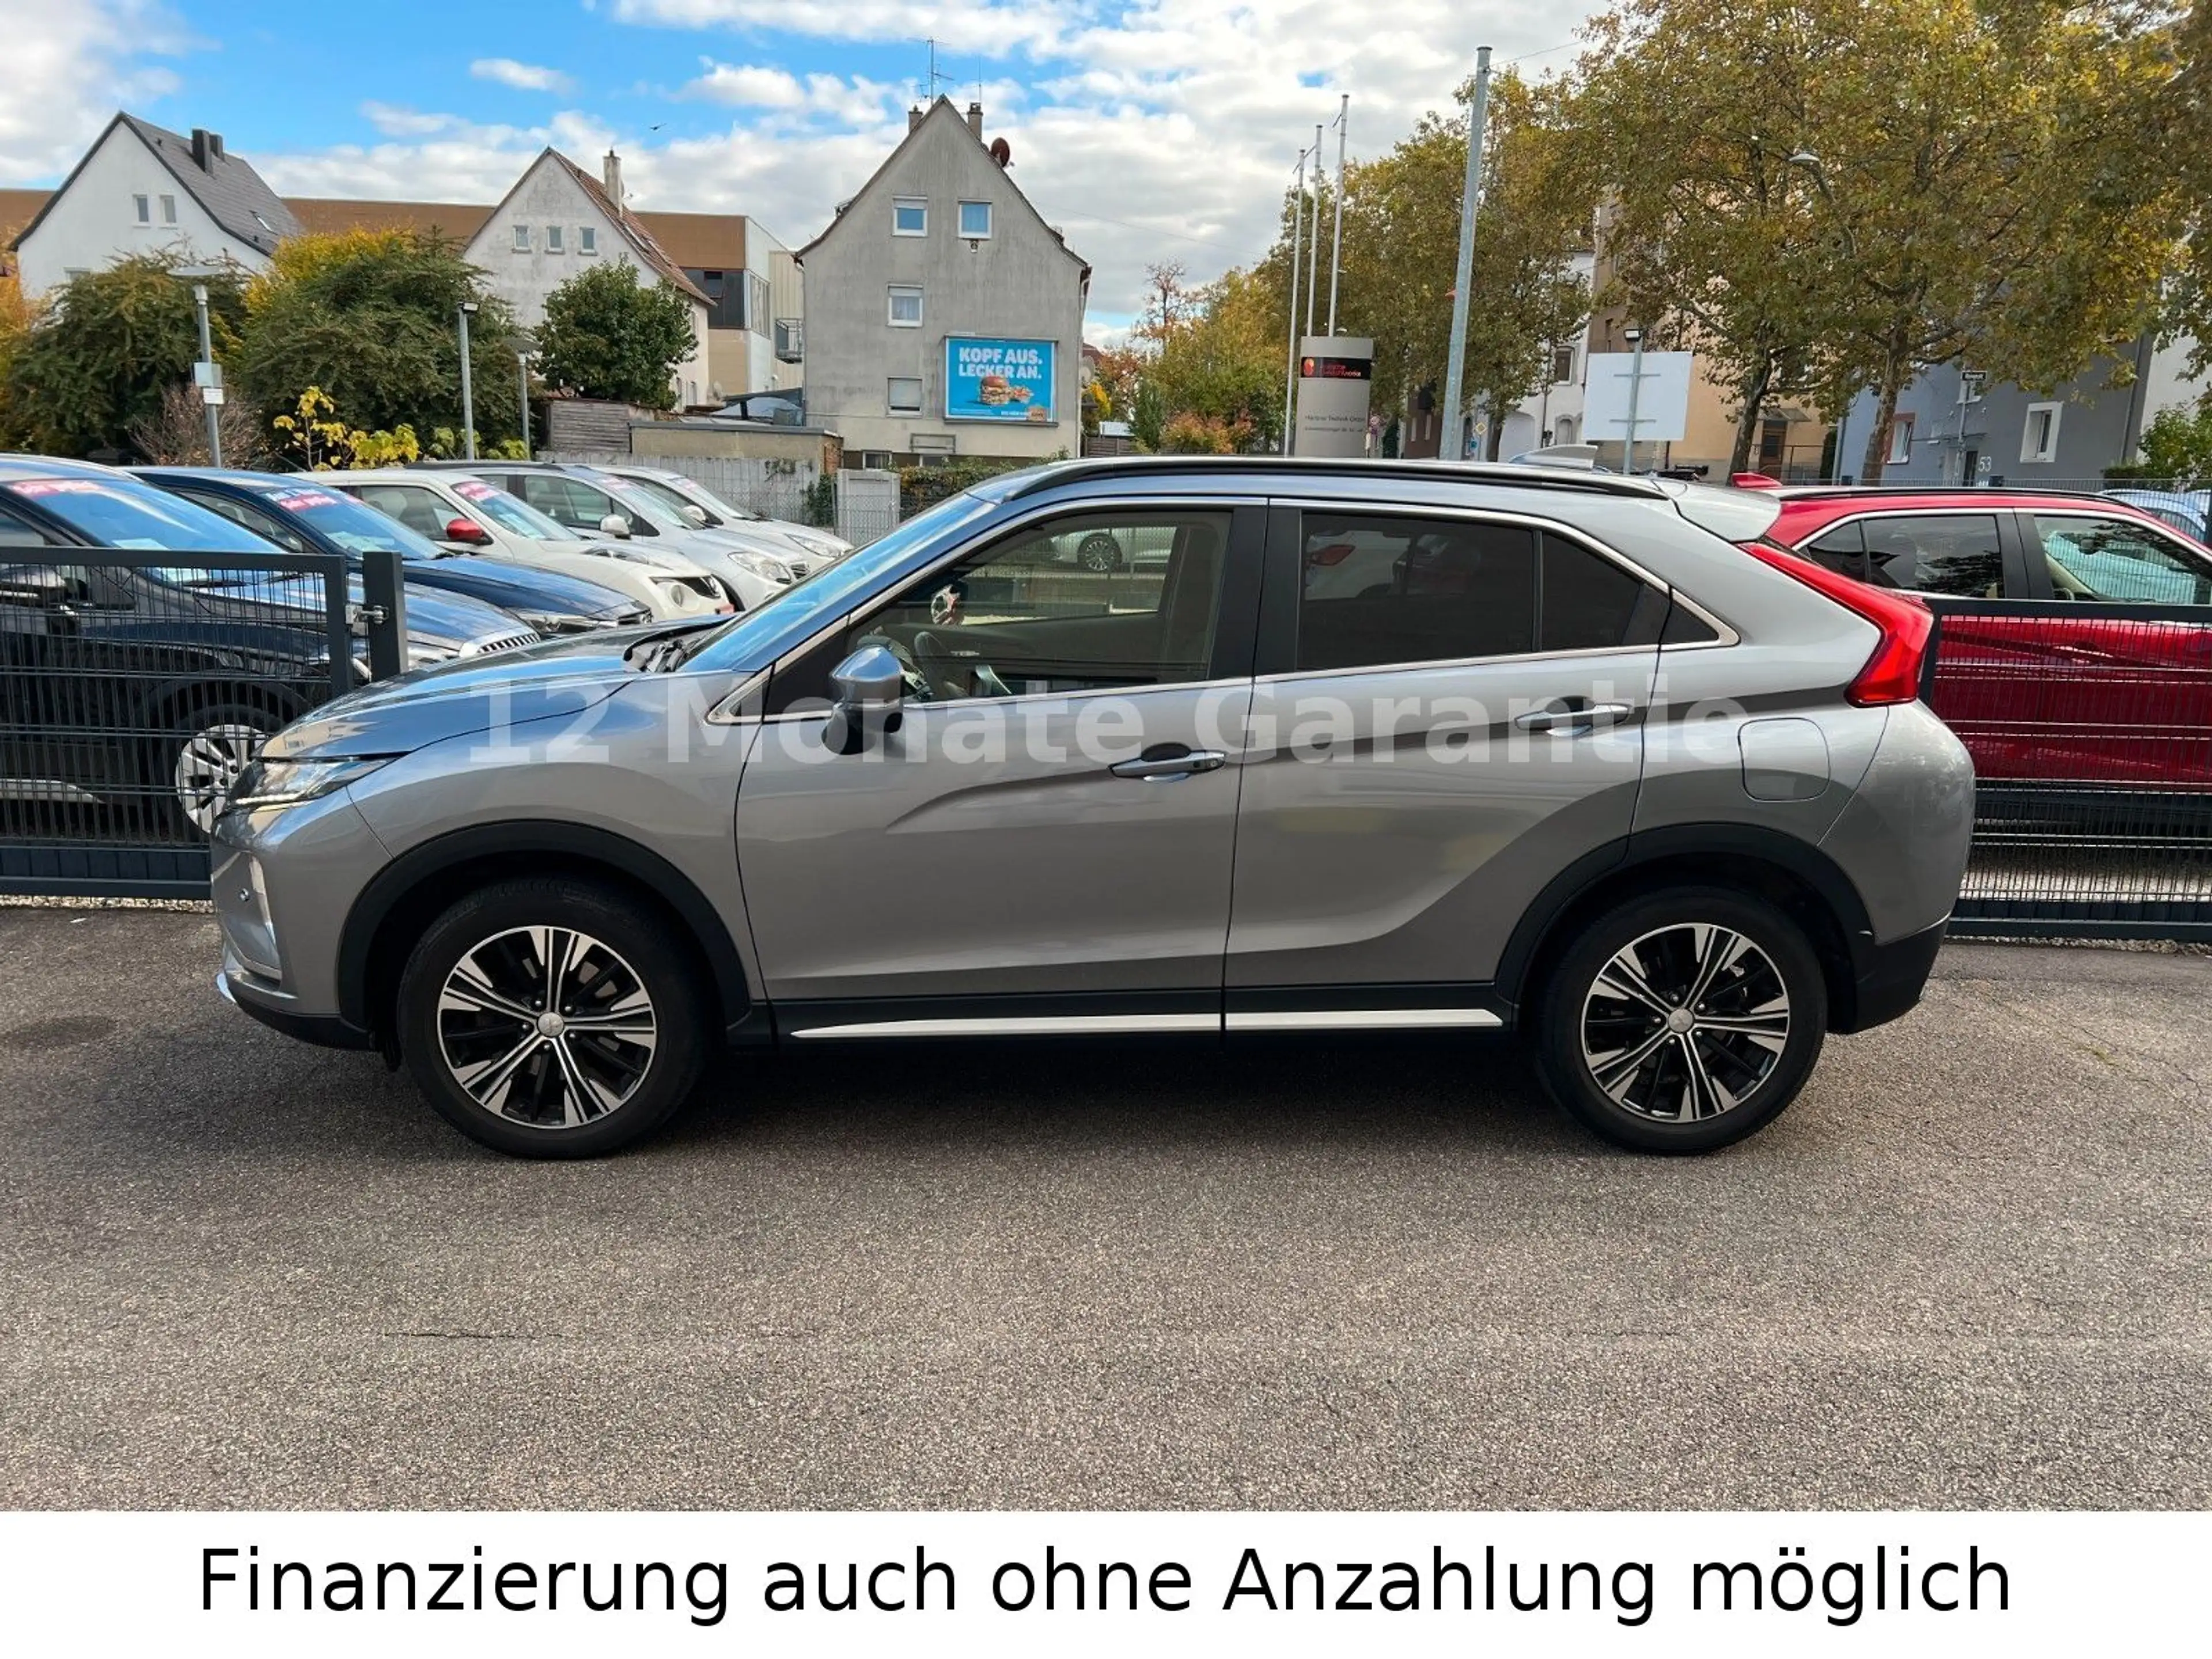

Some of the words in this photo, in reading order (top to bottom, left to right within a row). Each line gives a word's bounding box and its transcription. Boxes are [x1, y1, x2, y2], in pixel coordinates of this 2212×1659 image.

[959, 347, 1003, 363] KOPF
[1004, 349, 1043, 364] AUS.
[958, 364, 1014, 378] LECKER
[1016, 365, 1043, 380] AN.
[1978, 456, 1992, 472] 53
